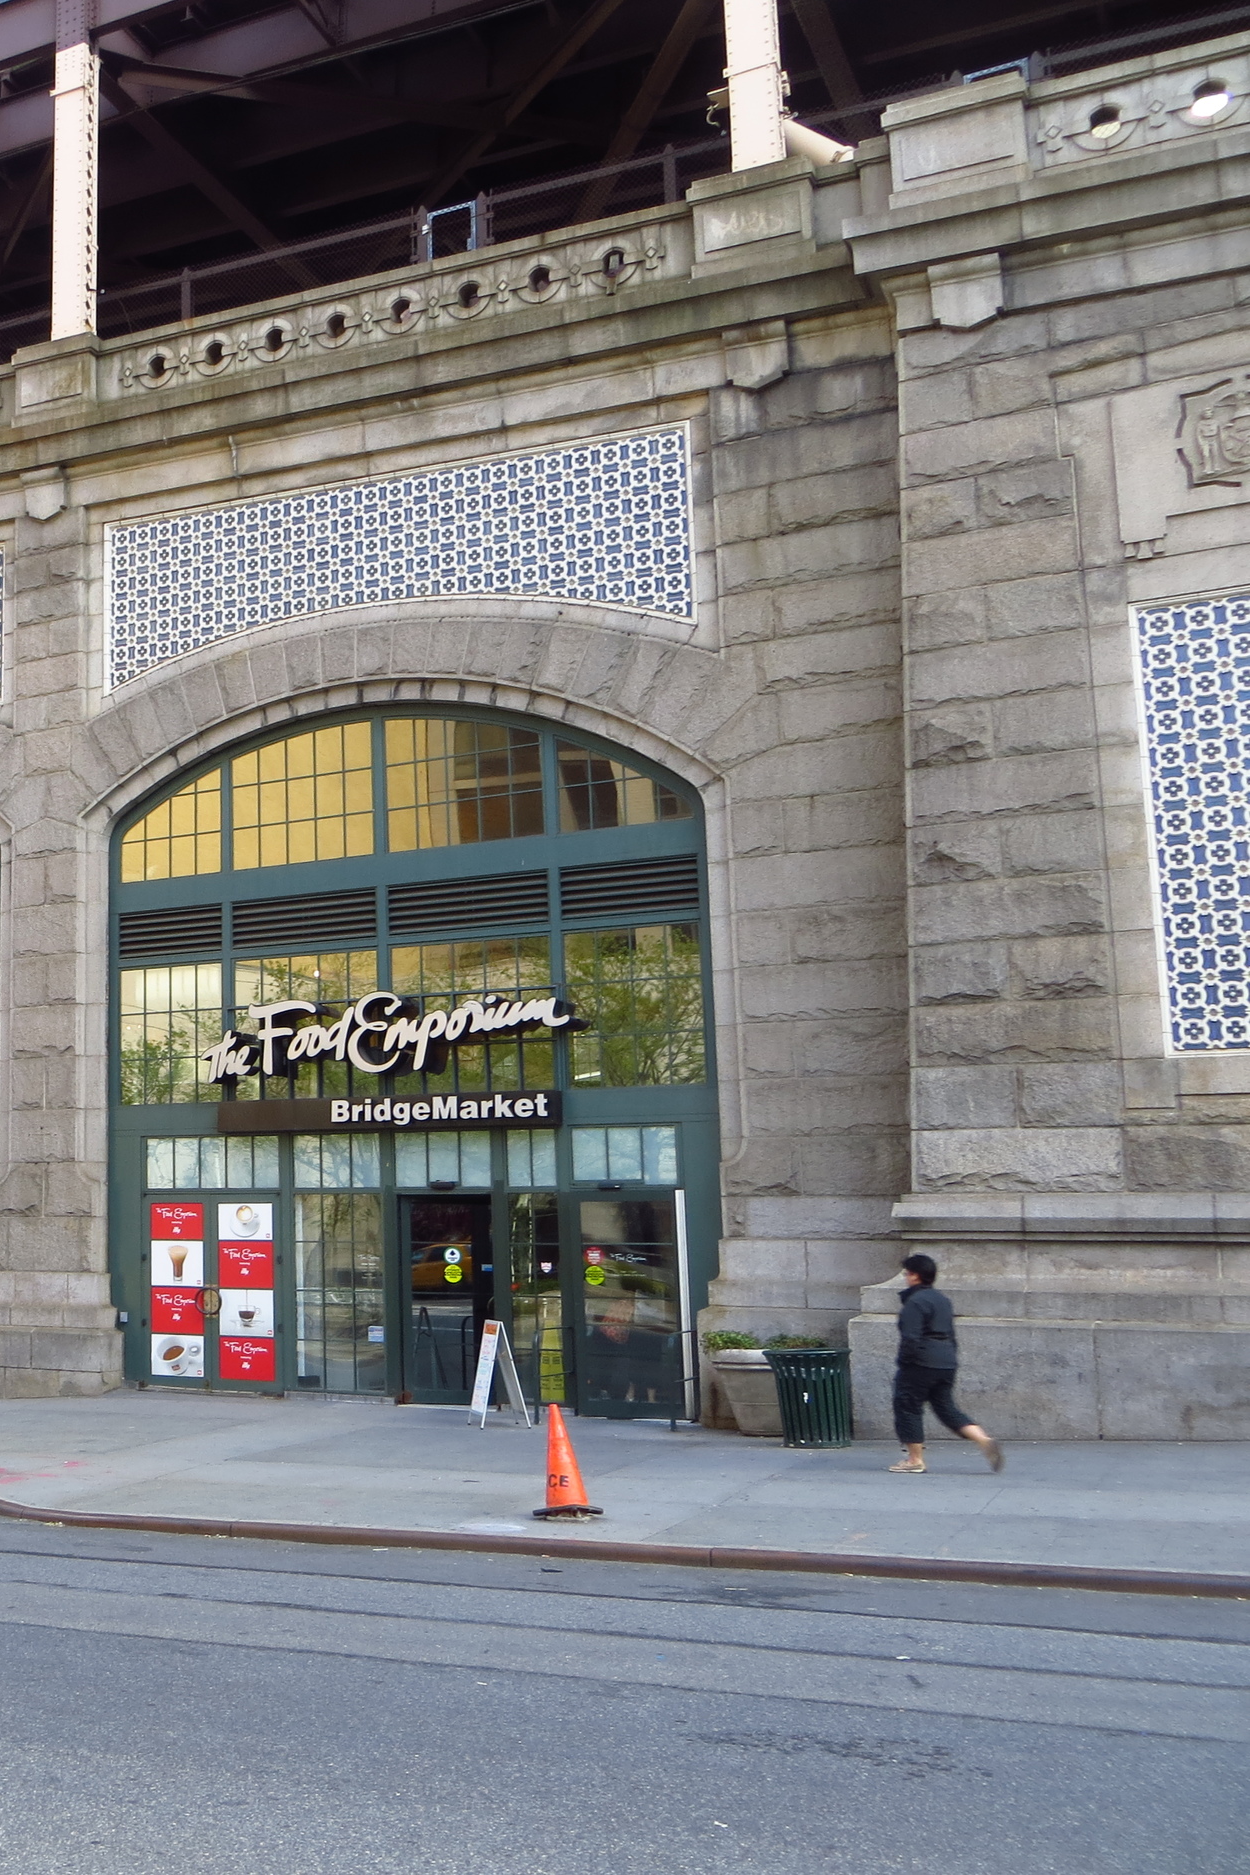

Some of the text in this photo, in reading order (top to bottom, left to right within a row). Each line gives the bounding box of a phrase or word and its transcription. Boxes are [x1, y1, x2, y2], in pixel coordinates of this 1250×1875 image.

[202, 991, 570, 1084] The Food Emporium
[330, 1093, 548, 1126] BridgeMarket
